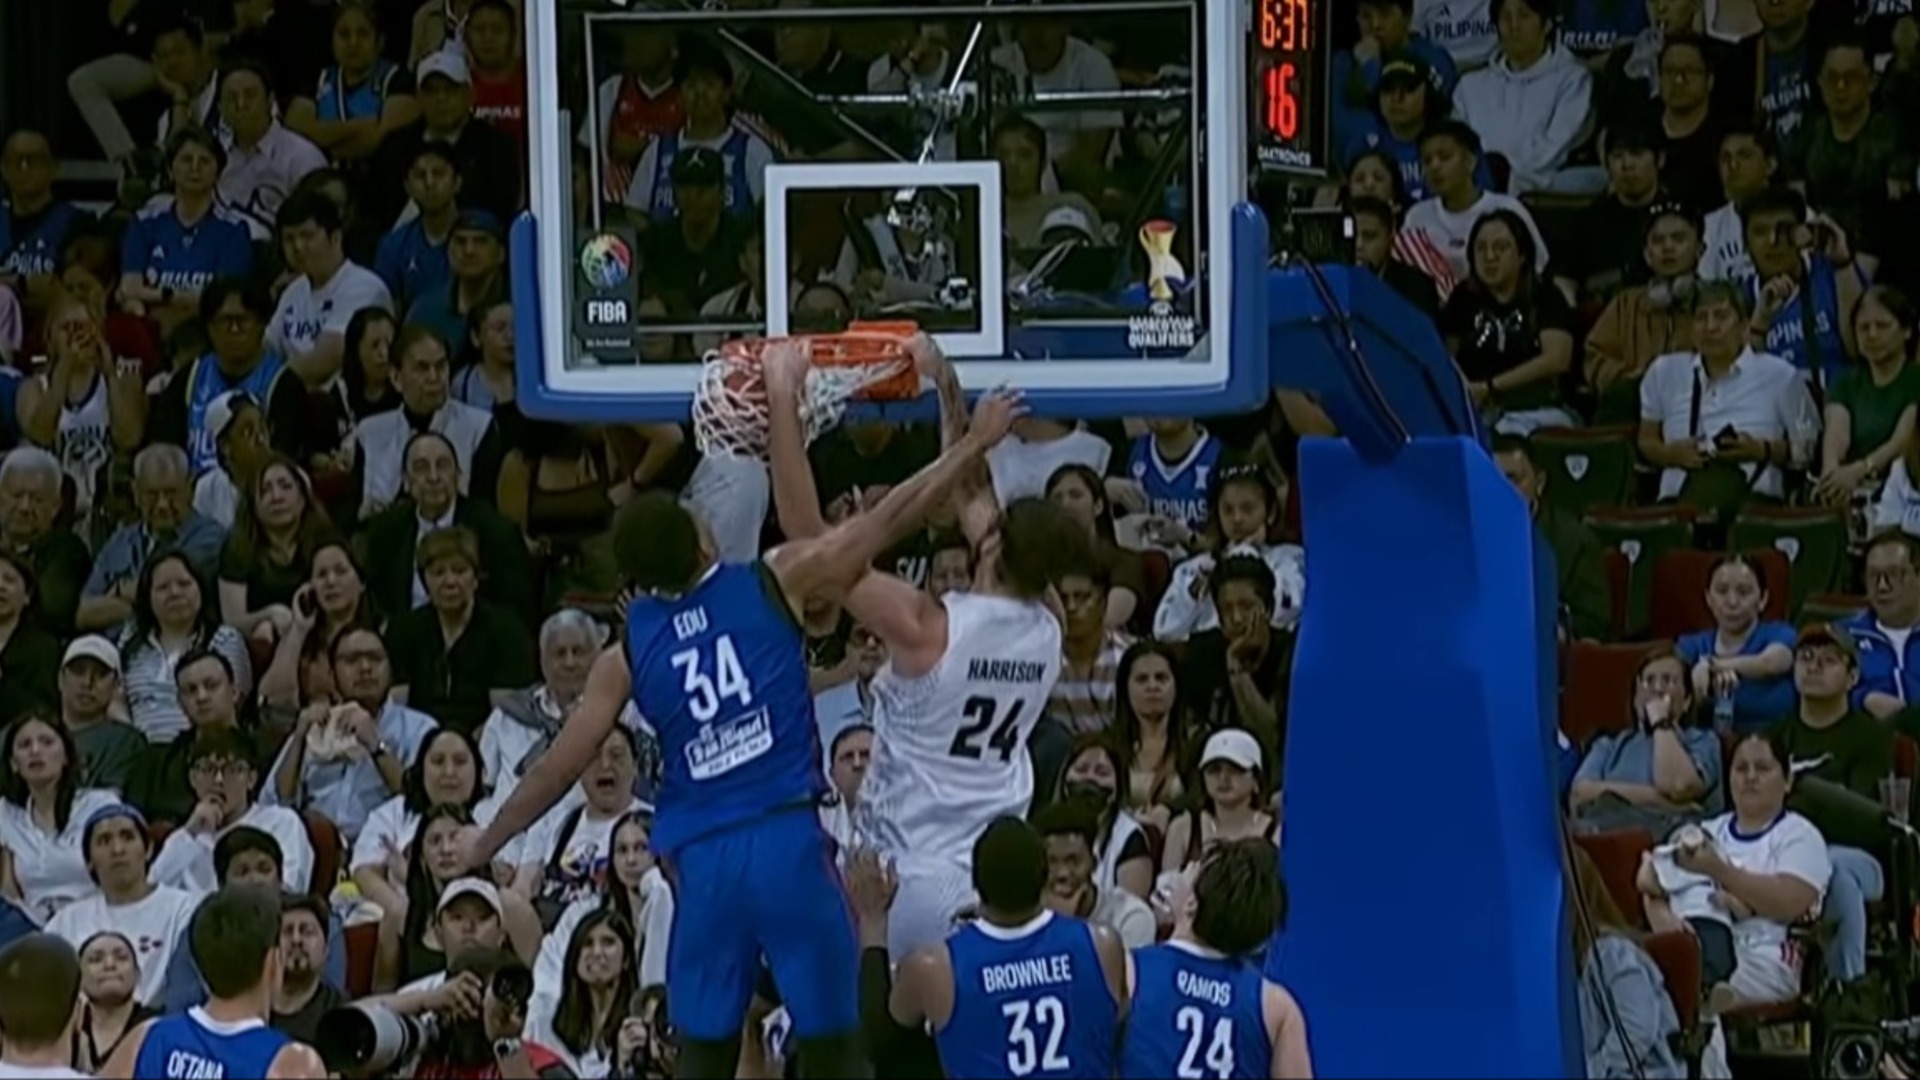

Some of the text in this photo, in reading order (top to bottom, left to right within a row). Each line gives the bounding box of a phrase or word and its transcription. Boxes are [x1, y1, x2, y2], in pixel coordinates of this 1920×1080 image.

[1261, 0, 1310, 51] 6:37
[1434, 20, 1497, 39] PILIPINA
[1267, 62, 1298, 138] 16
[587, 300, 628, 324] FIBA
[1128, 332, 1195, 350] QUALIFIERS
[672, 605, 709, 641] EDU
[671, 633, 752, 722] 34
[967, 658, 1046, 682] HARRISON
[949, 695, 1025, 762] 24
[982, 953, 1073, 993] BROWNLEE
[1177, 968, 1232, 1008] RAMOS
[1002, 995, 1070, 1077] 32
[1176, 1005, 1236, 1080] 24
